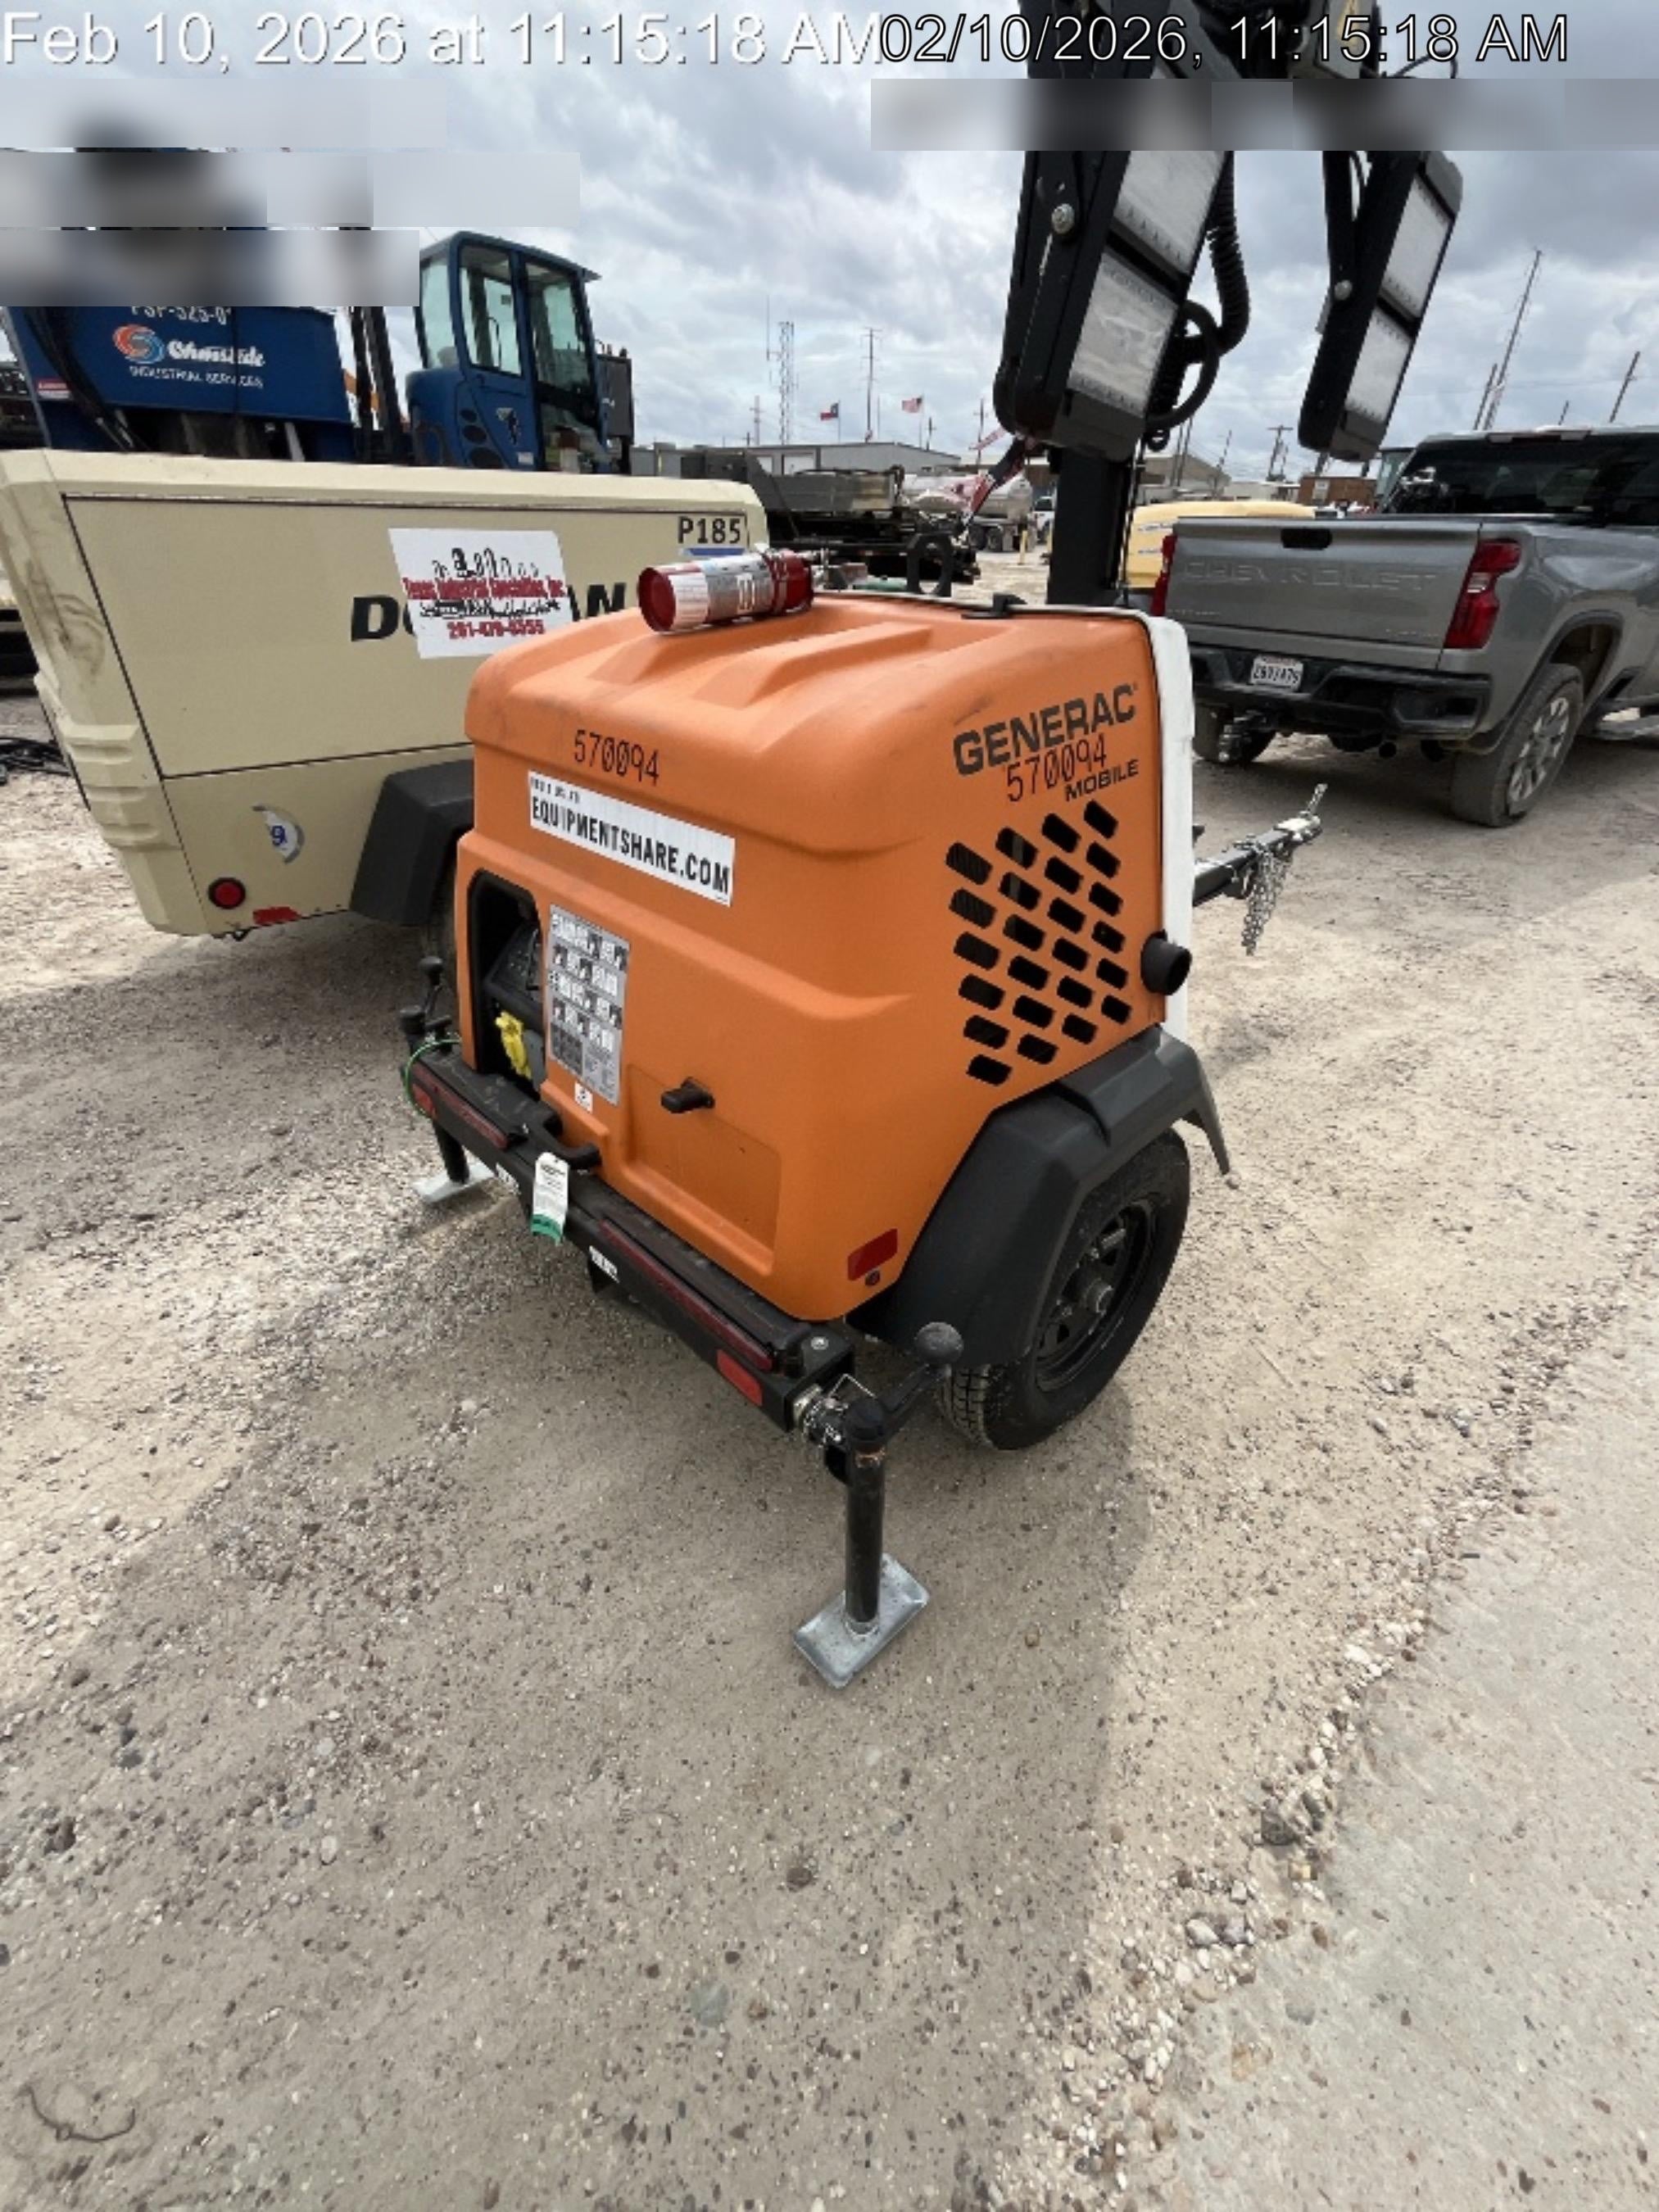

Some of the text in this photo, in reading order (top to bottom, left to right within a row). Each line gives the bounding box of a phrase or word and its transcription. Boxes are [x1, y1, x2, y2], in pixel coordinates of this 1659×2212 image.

[677, 515, 741, 544] P185
[574, 729, 660, 786] 570094
[954, 683, 1135, 777] GENERAC
[1007, 732, 1108, 803] 570094
[1065, 759, 1140, 802] MOBILE
[533, 796, 731, 894] EQUIPMENTSHARE.COM
